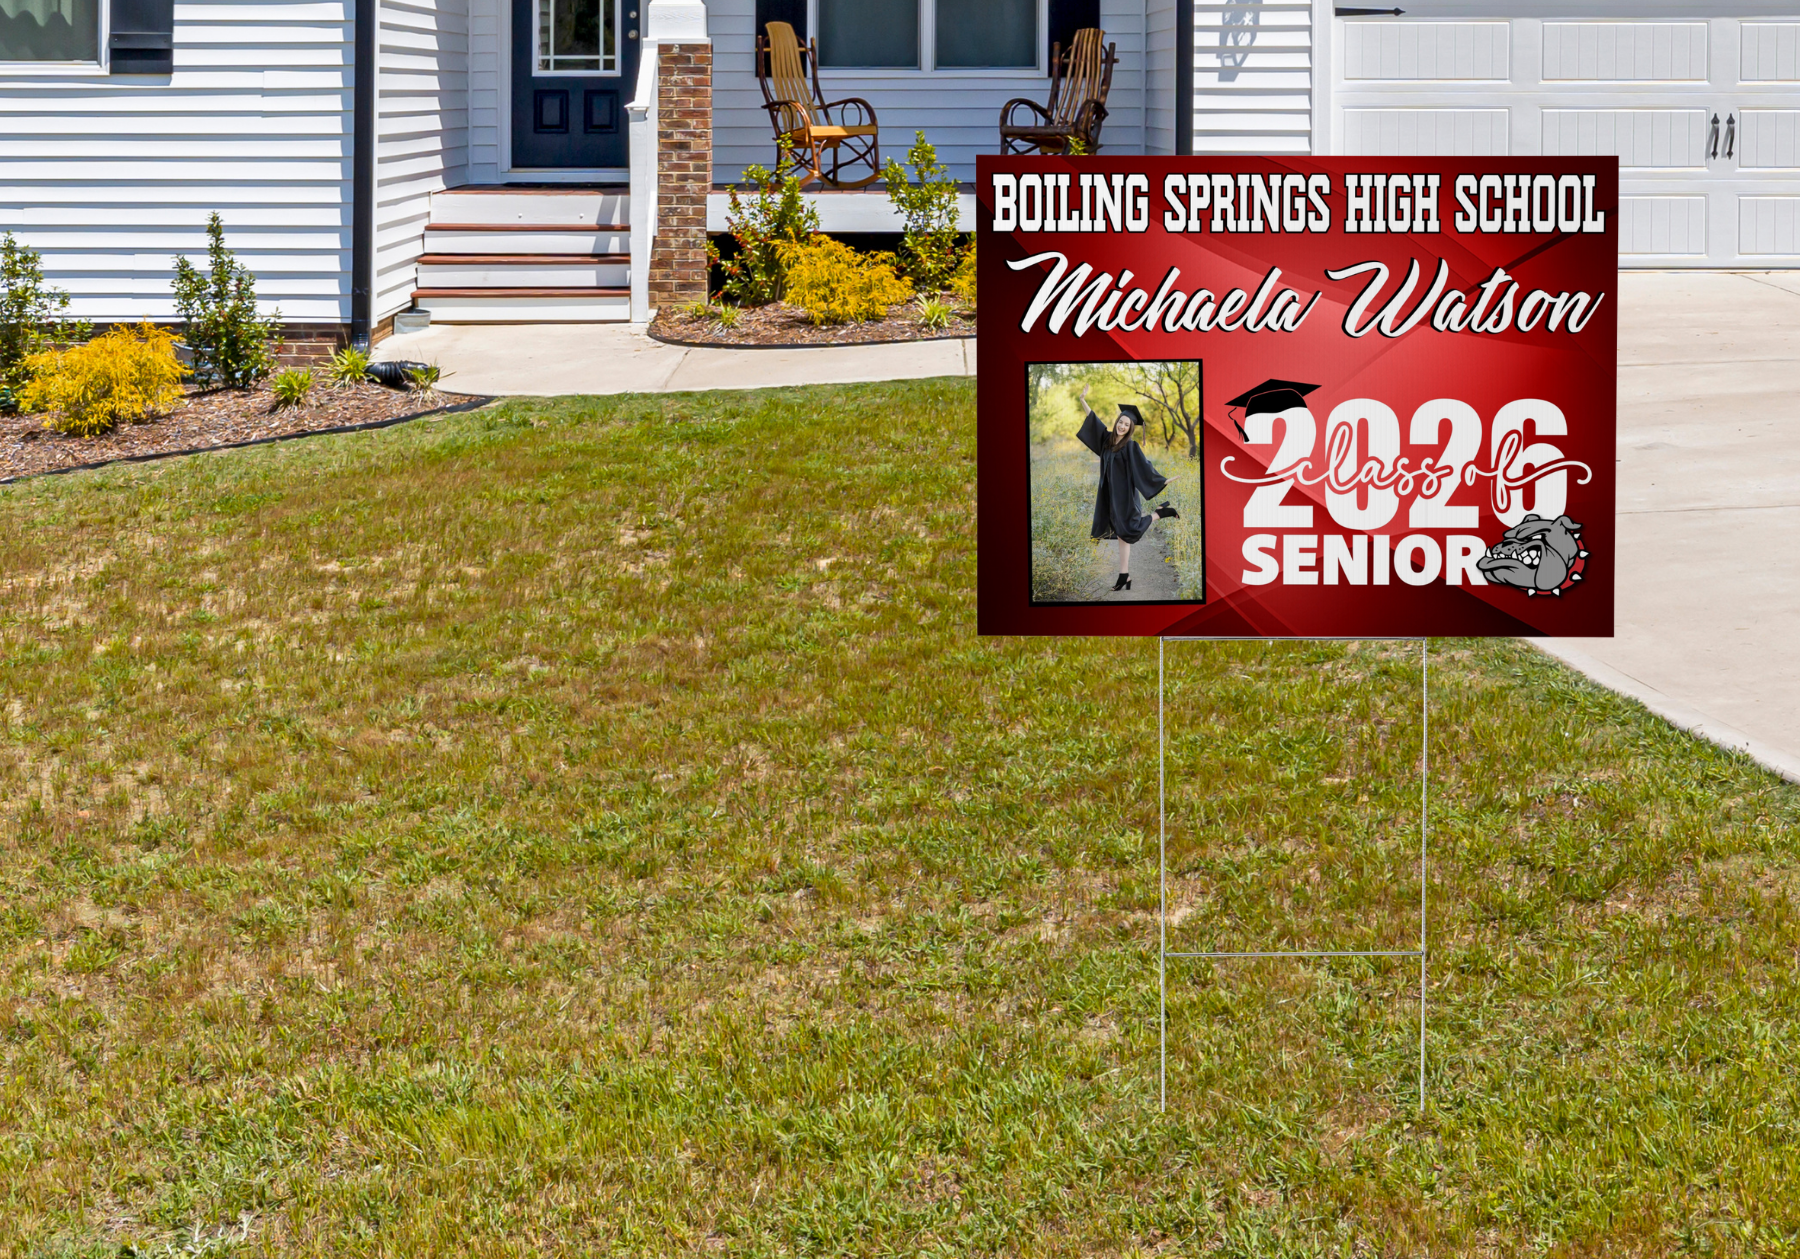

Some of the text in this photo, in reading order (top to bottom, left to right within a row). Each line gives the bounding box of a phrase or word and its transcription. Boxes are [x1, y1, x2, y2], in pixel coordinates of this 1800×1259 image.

[992, 173, 1605, 233] BOILING SPRINGS HIGH SCHOOL
[1006, 251, 1605, 339] Michaela Watson
[1220, 423, 1592, 511] class of
[1242, 398, 1569, 530] 2026
[1241, 533, 1489, 587] SENIOR
